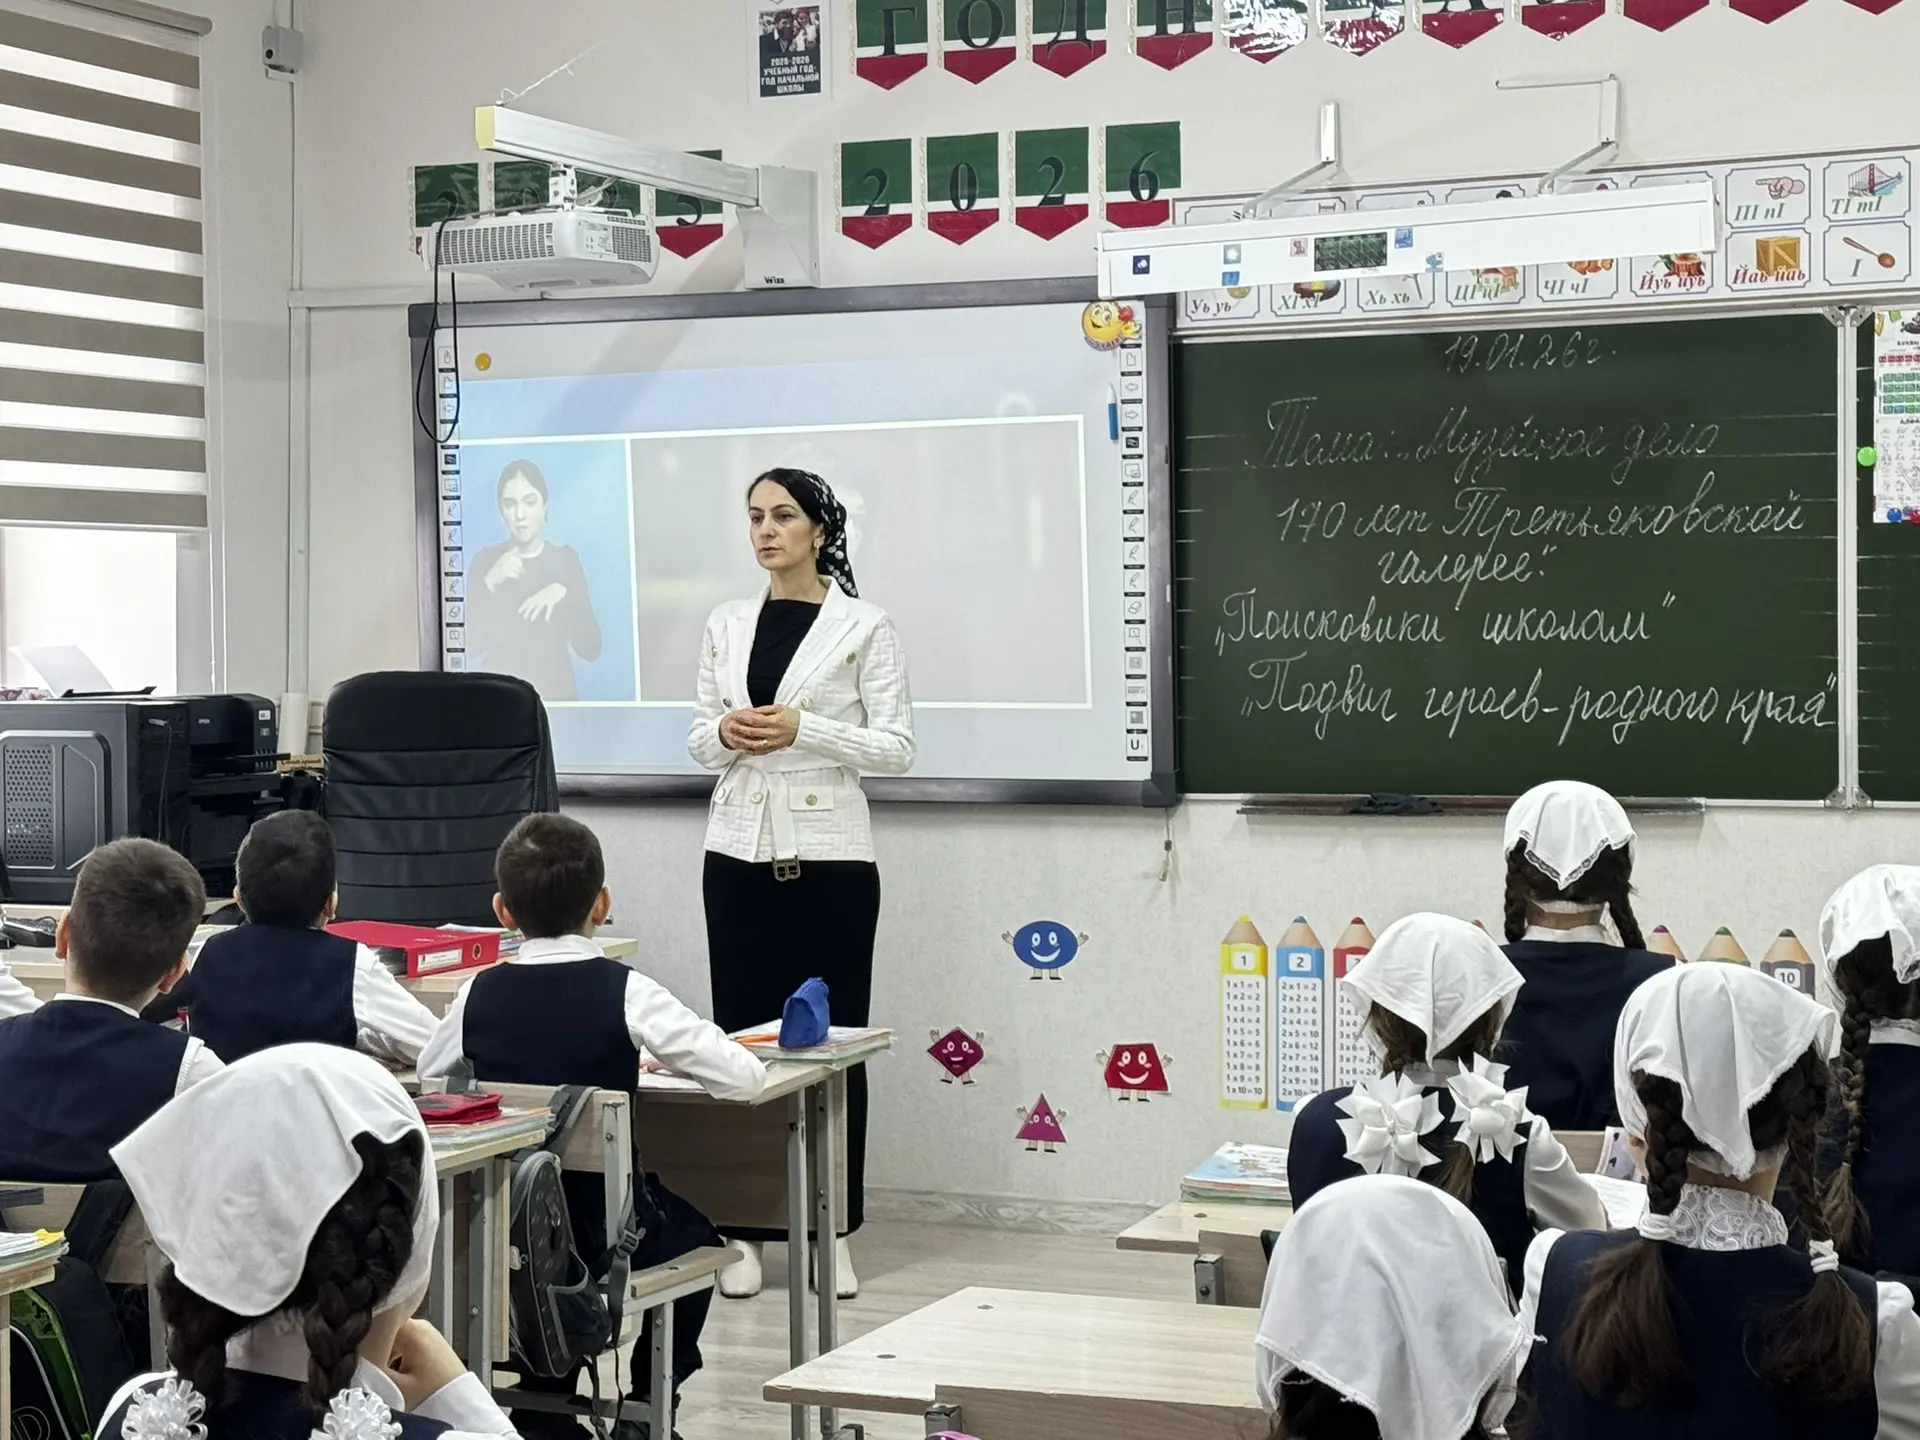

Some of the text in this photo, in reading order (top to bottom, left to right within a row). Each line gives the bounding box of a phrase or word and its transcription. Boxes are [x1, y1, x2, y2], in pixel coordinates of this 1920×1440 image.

[763, 65, 798, 76] УЧЕБНЫЙ
[761, 72, 820, 86] ГОД НАЧАЛЬНОЙ
[776, 84, 805, 94] ШКОЛЫ
[1276, 470, 1805, 566] 170 лет Третьяковской
[1296, 956, 1304, 968] 2
[1779, 972, 1796, 984] 10
